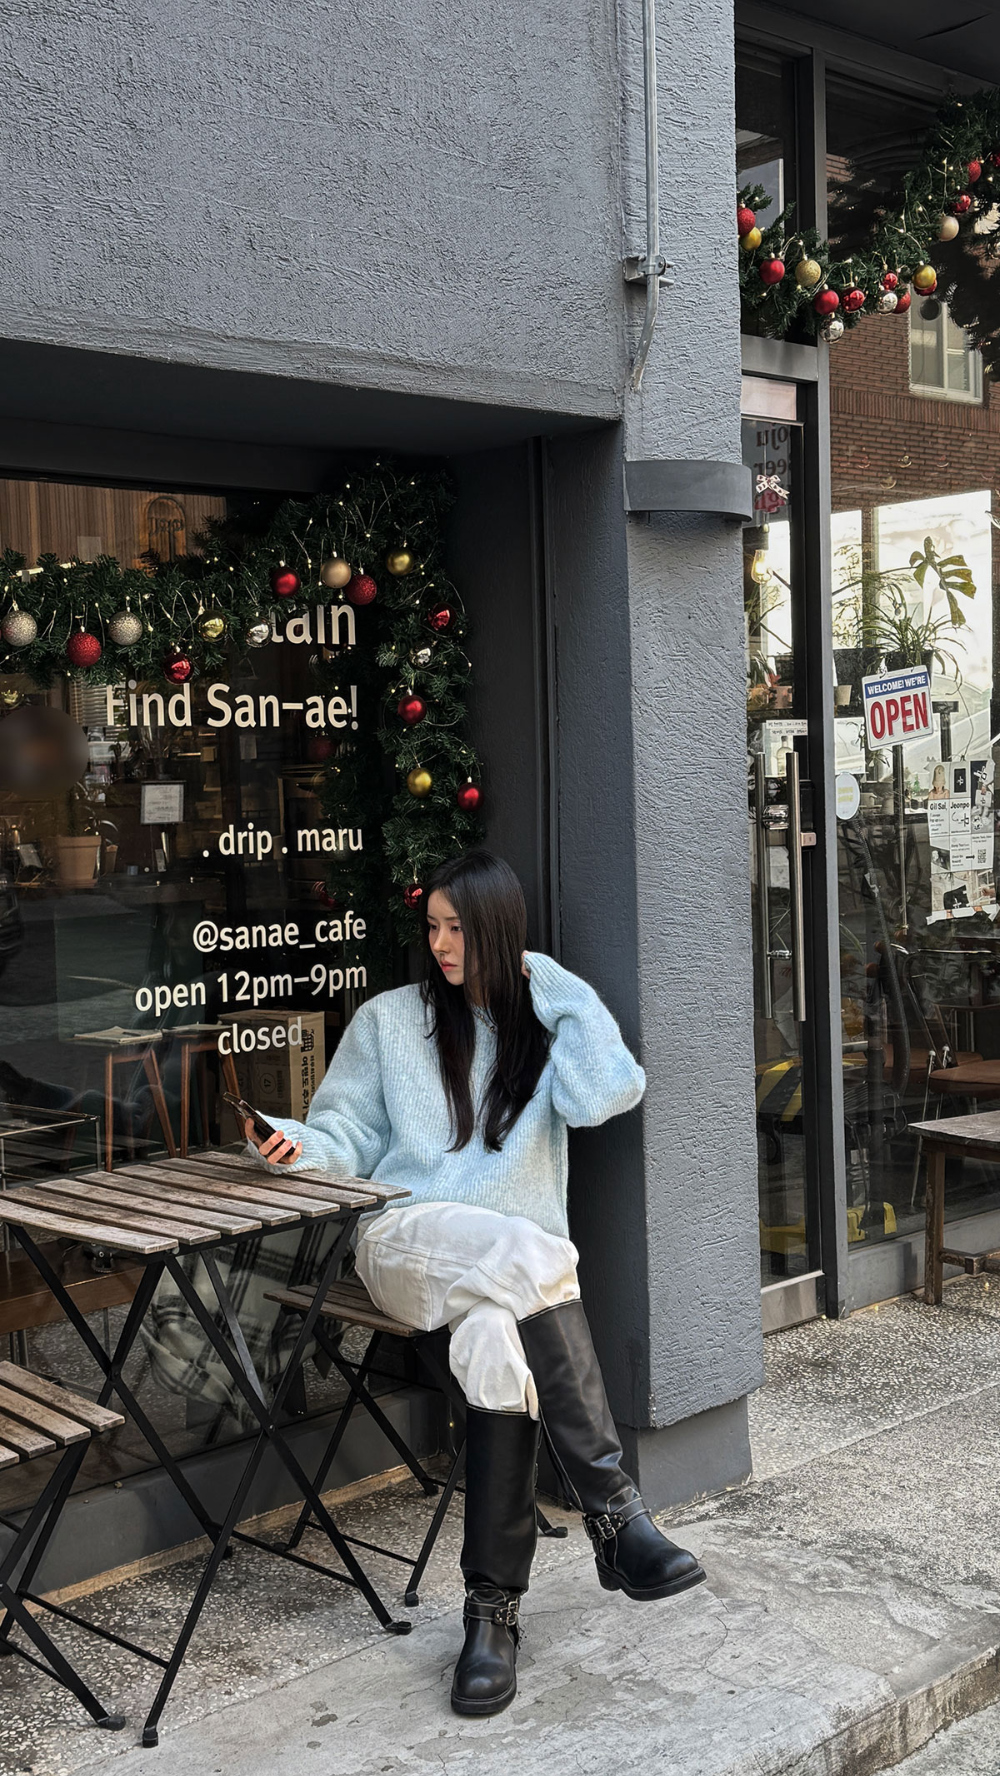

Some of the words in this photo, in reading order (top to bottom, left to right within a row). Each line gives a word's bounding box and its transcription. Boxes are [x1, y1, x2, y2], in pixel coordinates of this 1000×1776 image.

[904, 675, 926, 687] WE'RE
[106, 679, 193, 727] Find
[870, 691, 929, 740] OPEN
[218, 822, 273, 861] drip
[297, 828, 364, 852] maru
[192, 910, 367, 953] @sanae_cafe
[135, 981, 206, 1017] open
[217, 1016, 303, 1055] closed
